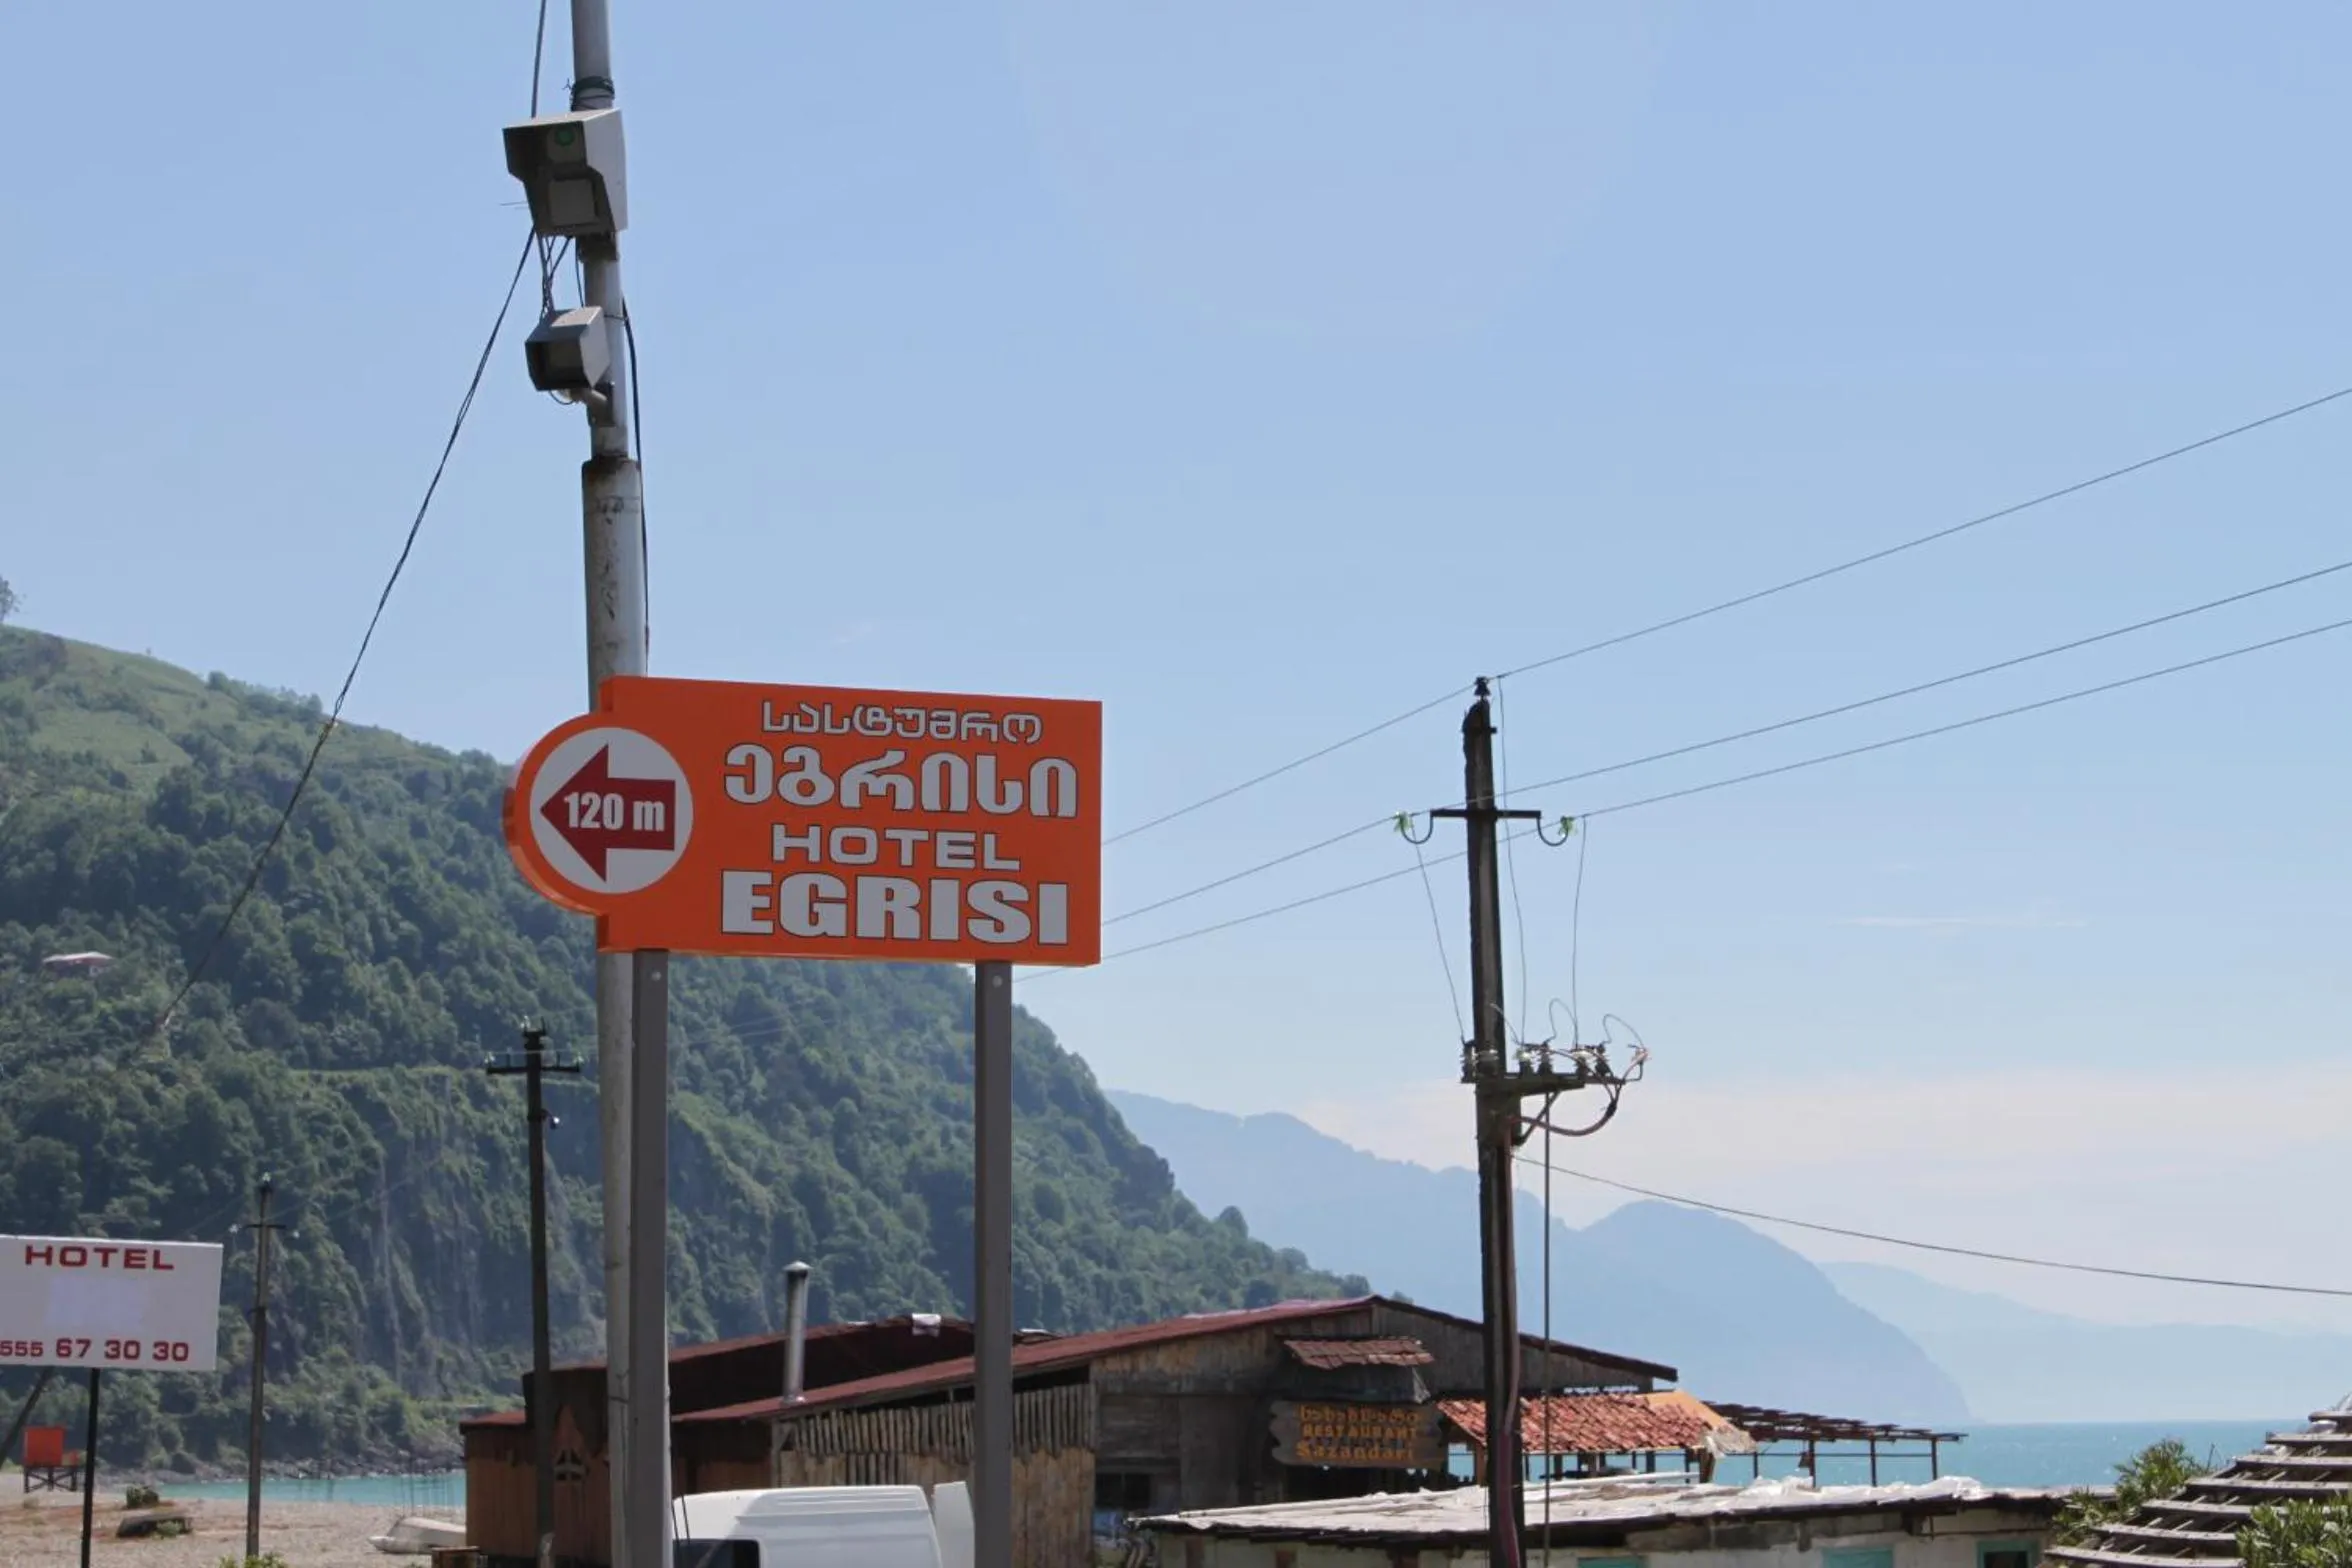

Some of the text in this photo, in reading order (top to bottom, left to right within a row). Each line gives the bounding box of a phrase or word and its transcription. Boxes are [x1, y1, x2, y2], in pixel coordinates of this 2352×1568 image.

[761, 701, 1043, 744] სასტუმრო
[723, 743, 1079, 818] ეგრისი
[563, 792, 666, 833] 120 m
[771, 823, 1021, 872] HOTEL
[720, 869, 1069, 945] EGRISI
[25, 1245, 174, 1270] HOTEL
[0, 1338, 189, 1362] 555 67 30 30
